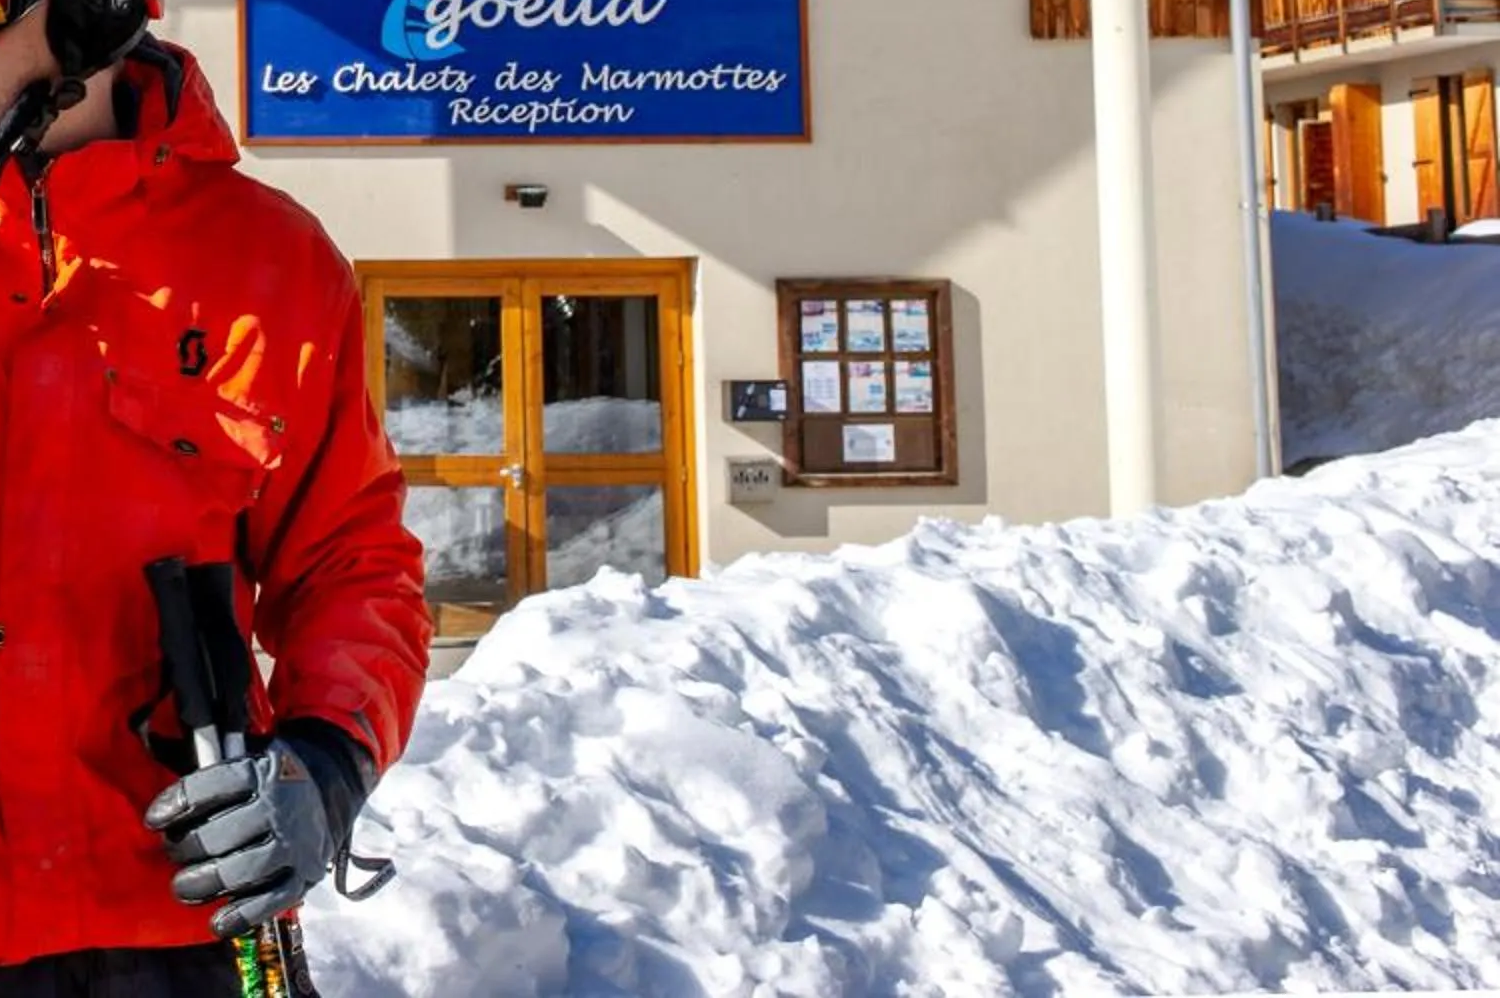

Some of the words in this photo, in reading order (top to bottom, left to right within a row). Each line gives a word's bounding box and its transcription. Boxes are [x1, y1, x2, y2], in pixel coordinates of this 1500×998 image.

[261, 63, 318, 94] Les
[333, 62, 476, 93] Chalets
[495, 62, 562, 92] des
[581, 62, 786, 93] Marmottes
[448, 97, 634, 133] Réception
